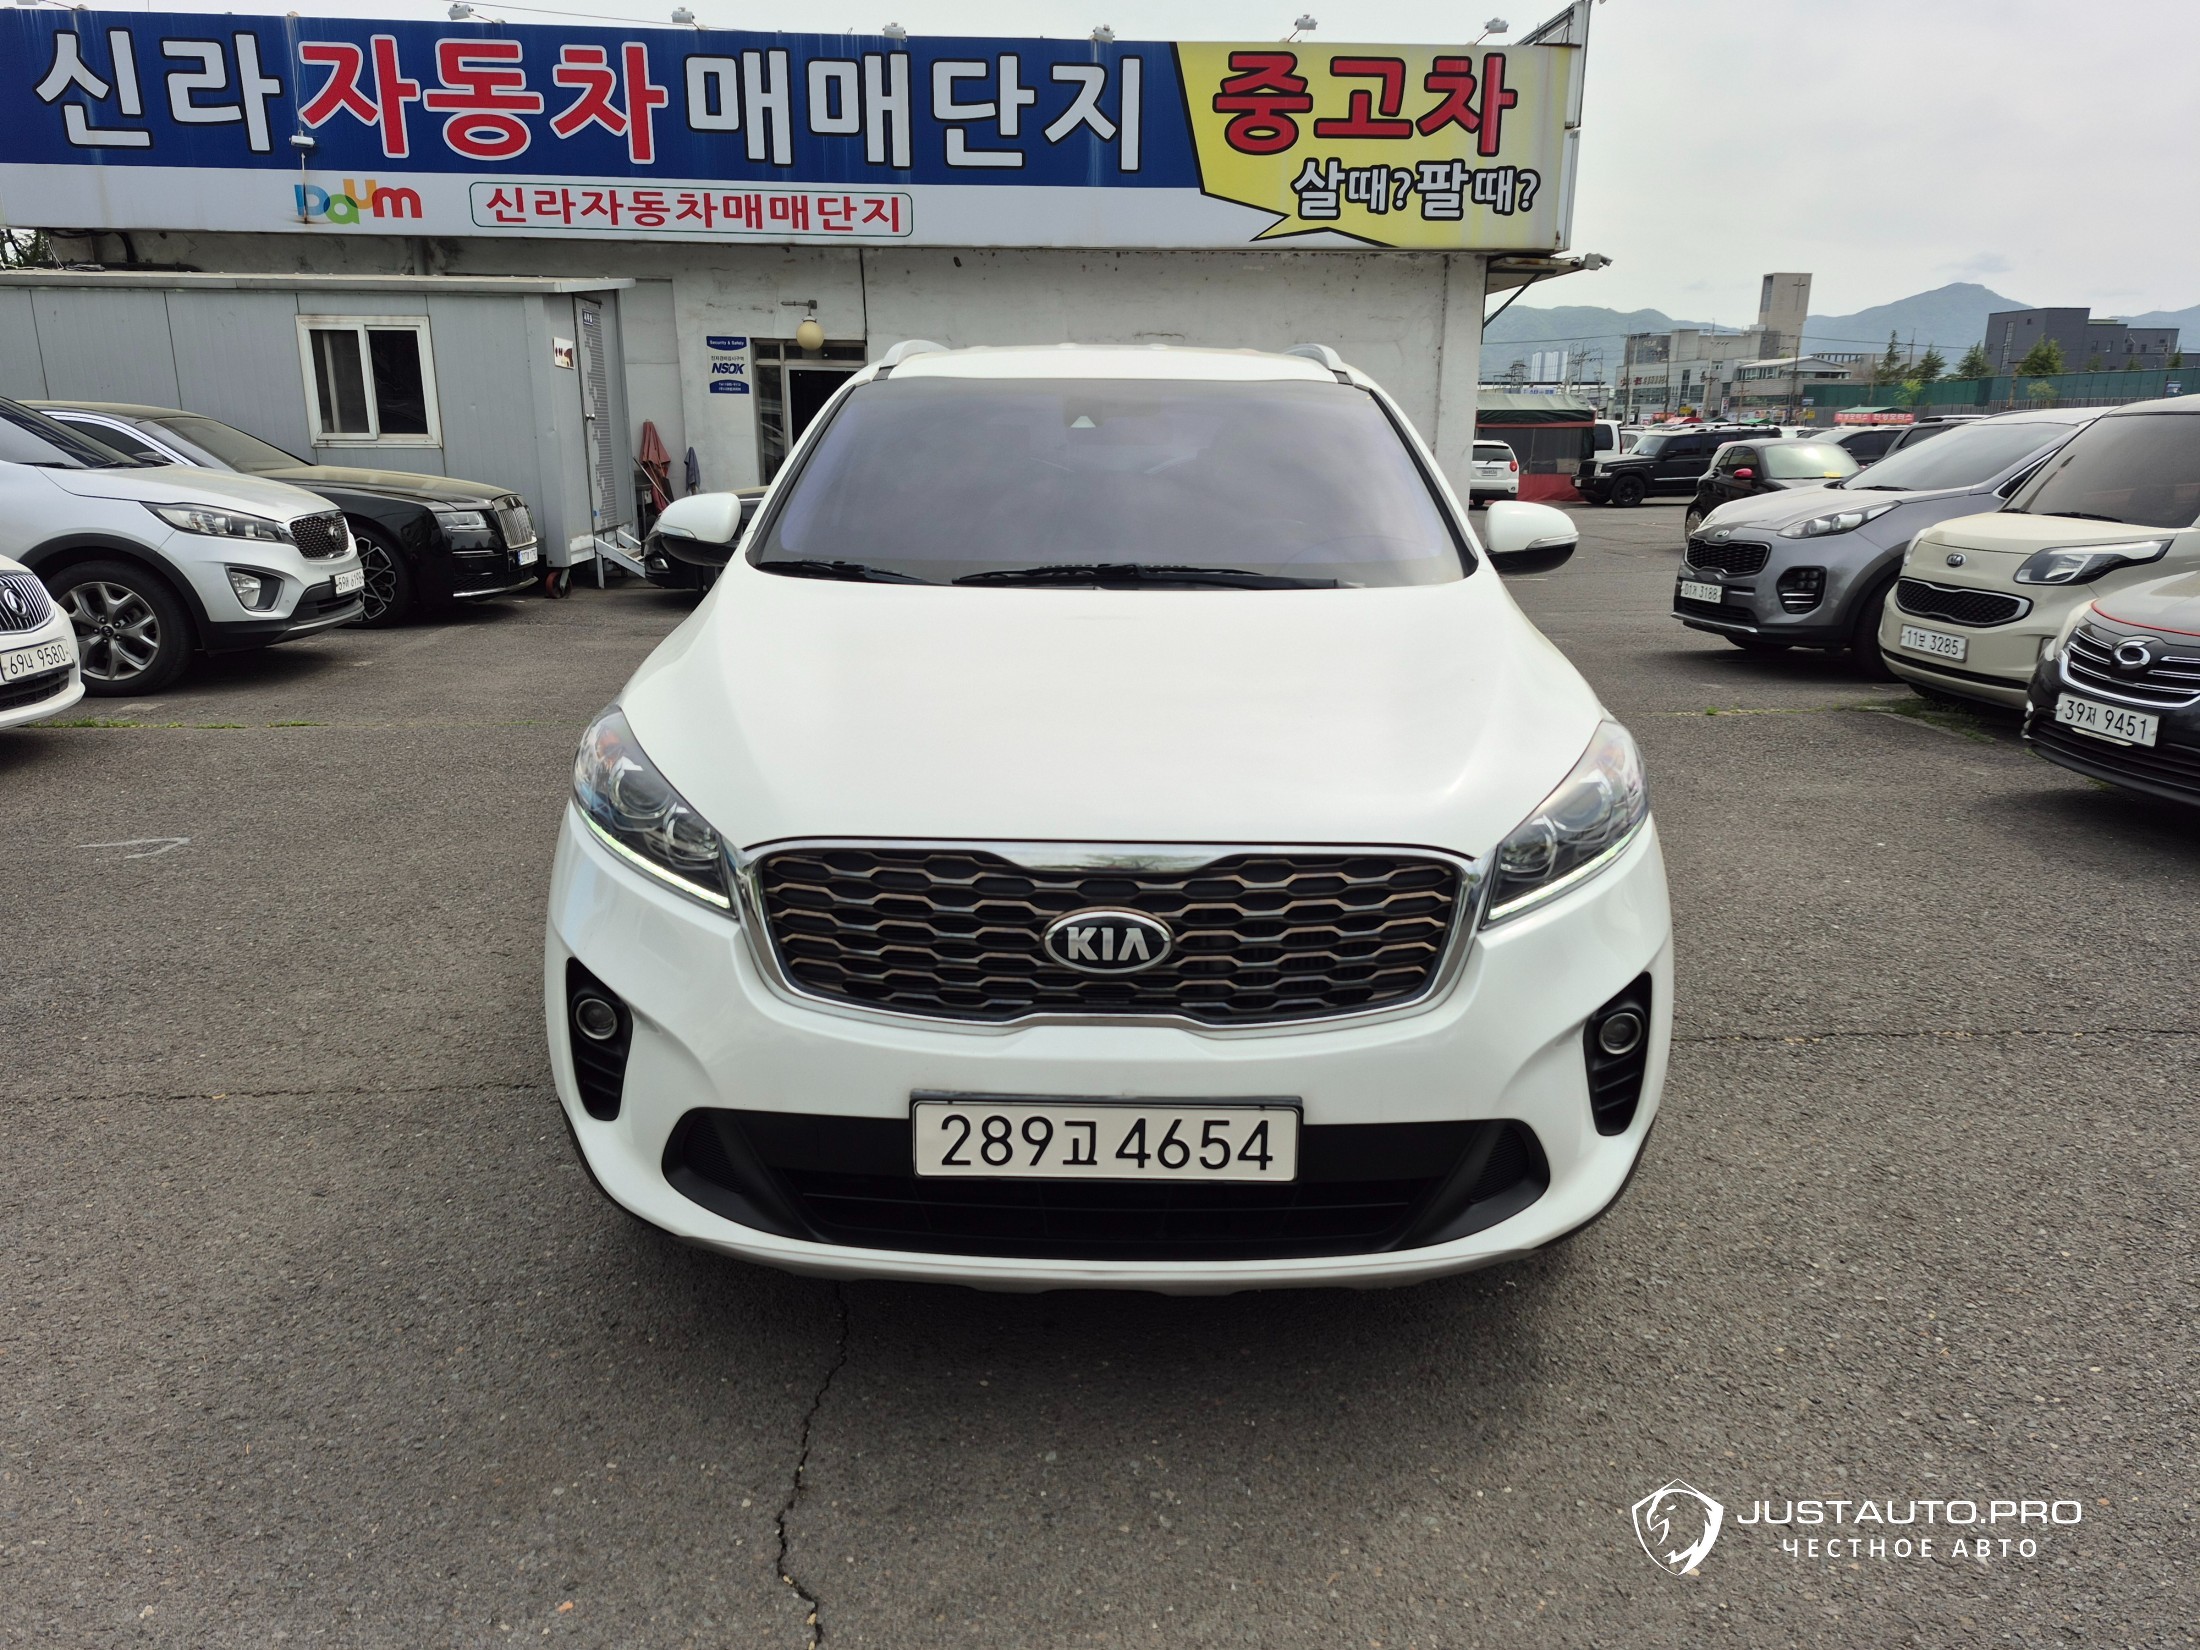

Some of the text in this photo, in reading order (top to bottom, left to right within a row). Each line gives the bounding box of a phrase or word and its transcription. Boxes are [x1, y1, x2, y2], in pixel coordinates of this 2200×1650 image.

[1212, 51, 1518, 157] 중고차
[487, 188, 900, 233] 신라자동차매매단지
[711, 362, 746, 375] NSOK
[10, 644, 66, 675] 69너 9580
[1929, 634, 1959, 655] 3285
[2065, 700, 2147, 740] 39저 9451
[1067, 926, 1151, 961] KIA
[941, 1114, 1274, 1171] 289고 4654
